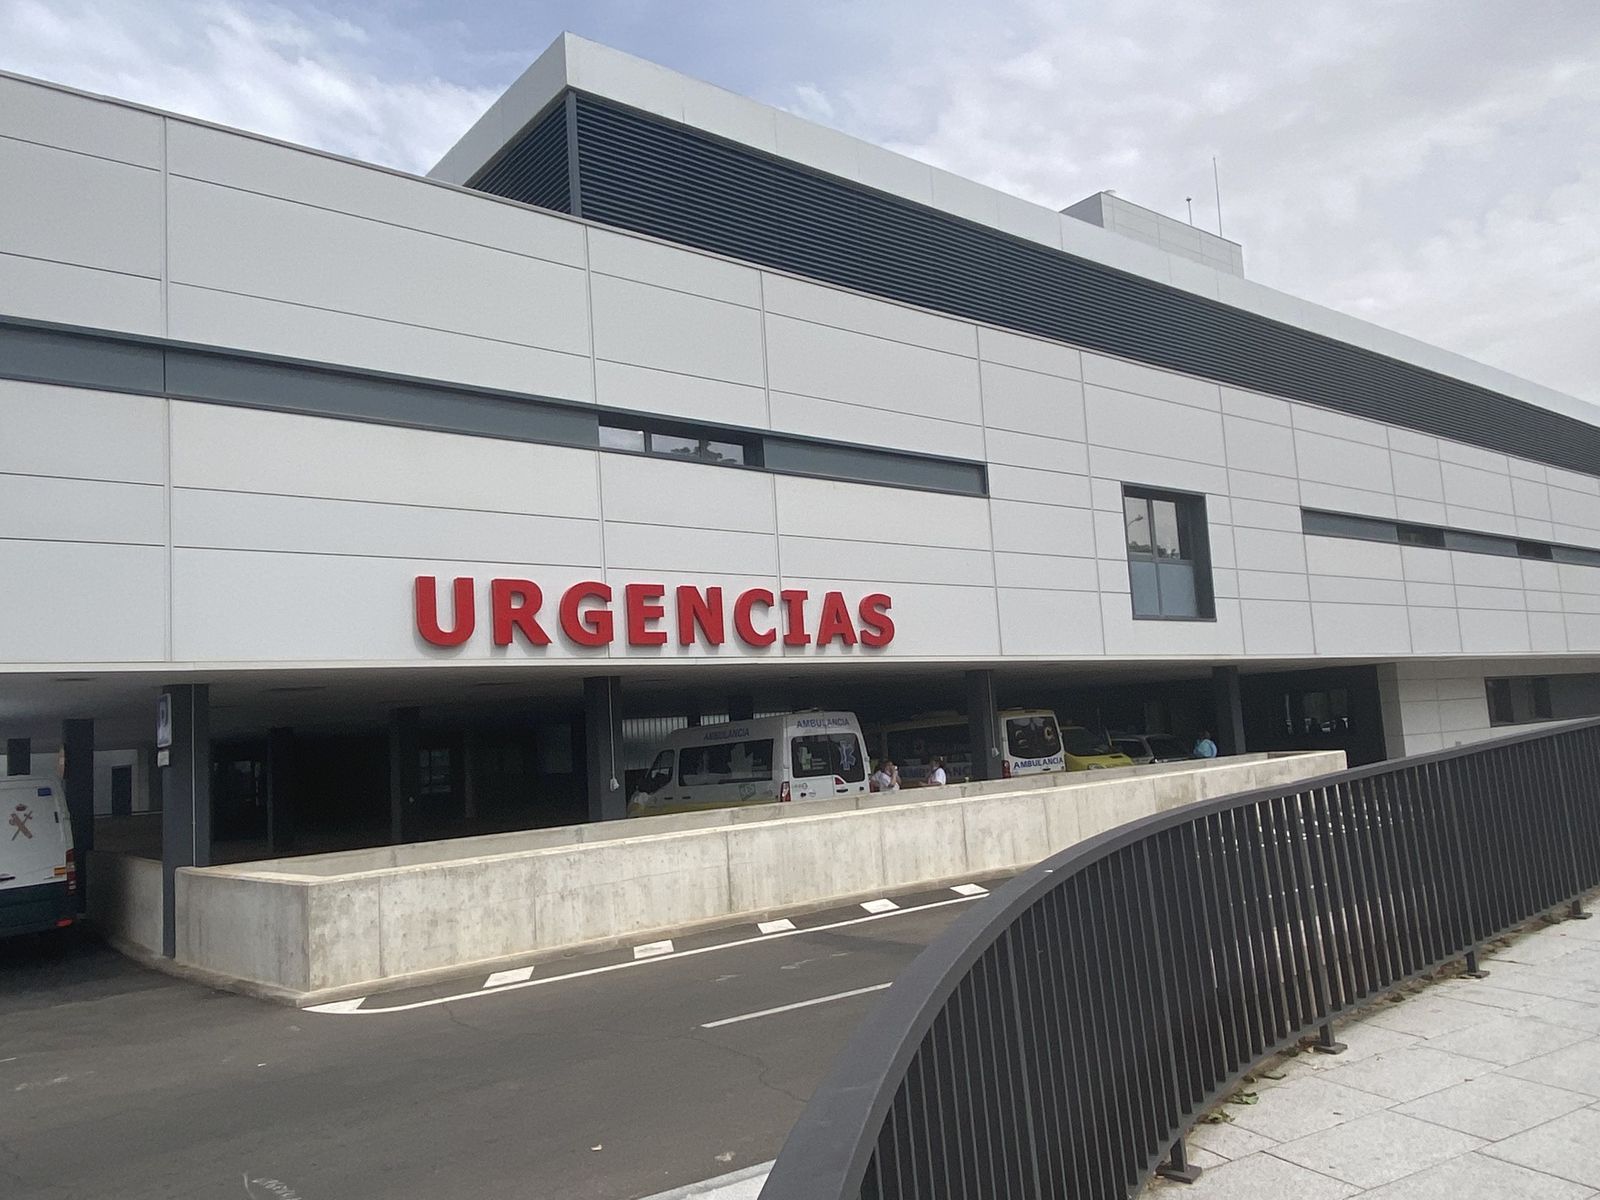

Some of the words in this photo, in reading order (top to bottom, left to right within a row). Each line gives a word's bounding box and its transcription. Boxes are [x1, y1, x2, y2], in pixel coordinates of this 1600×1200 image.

[415, 576, 895, 647] URGENCIAS
[797, 717, 850, 729] AMBULANCIA
[1013, 757, 1064, 769] AMBULANCIA
